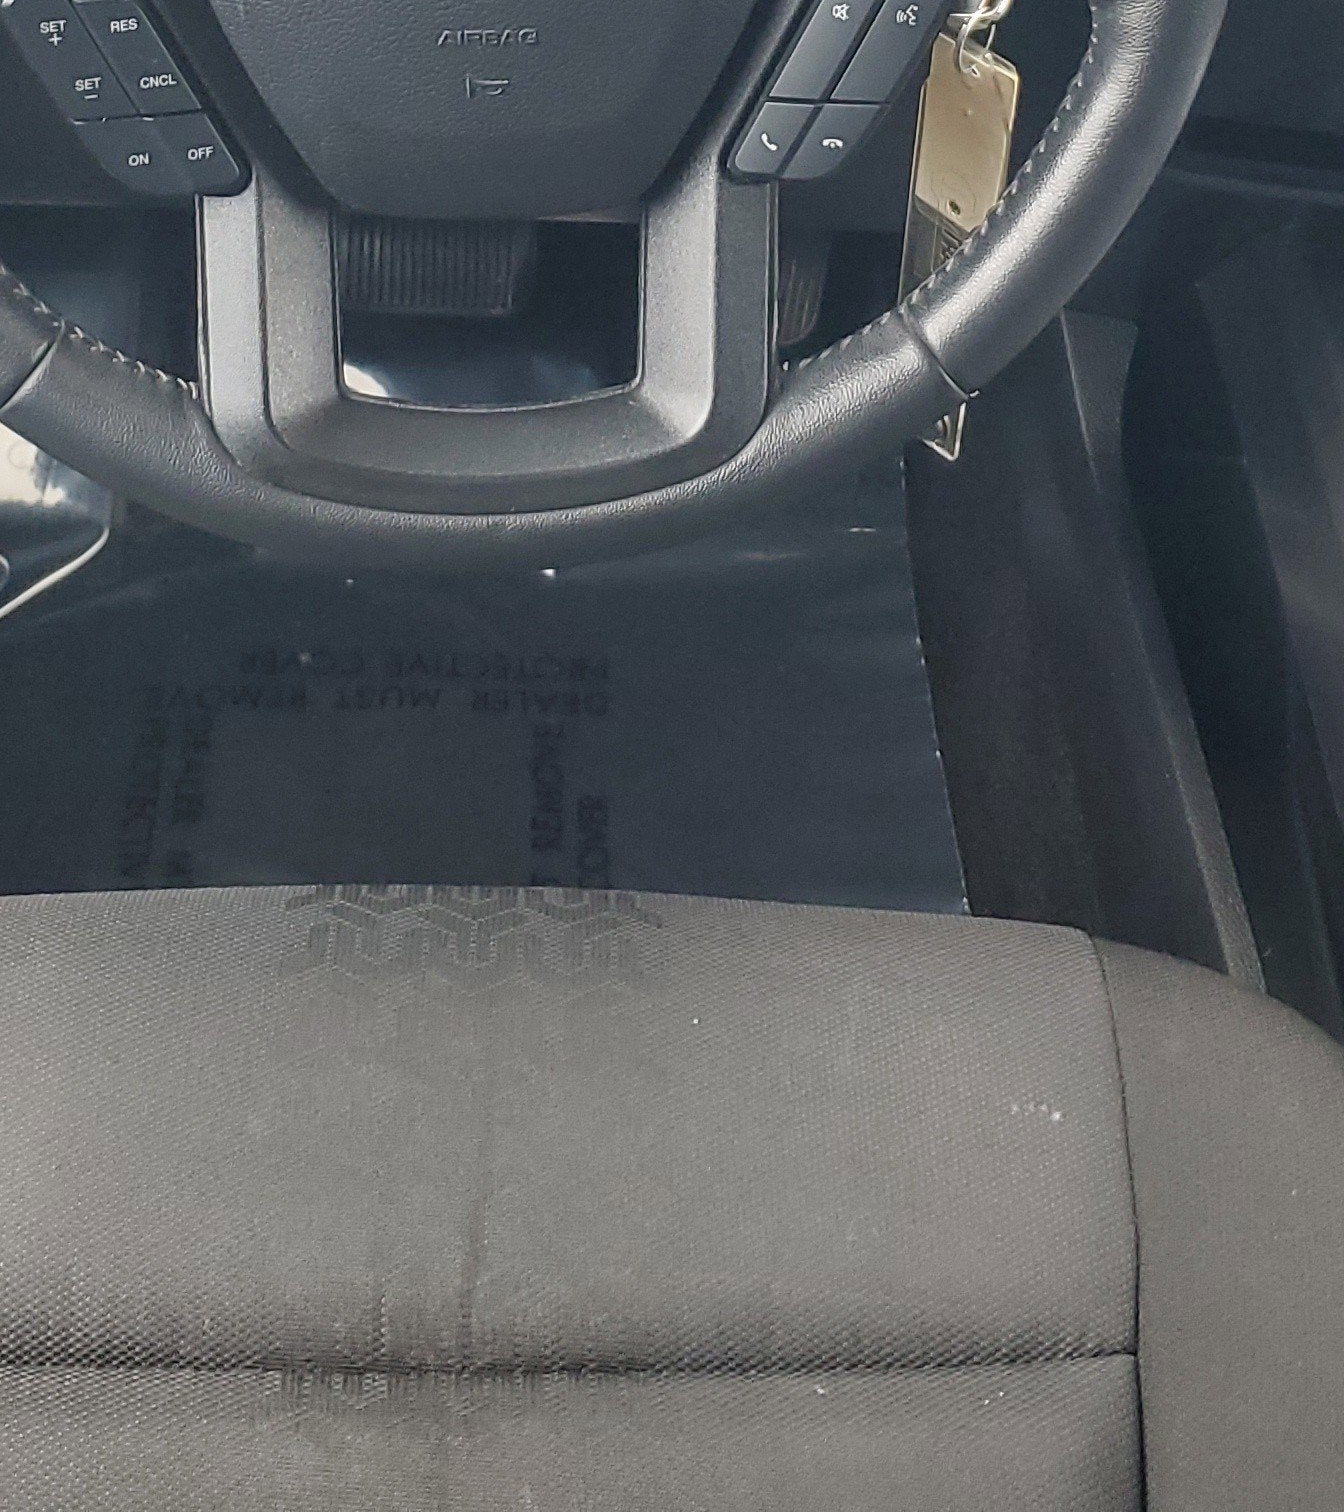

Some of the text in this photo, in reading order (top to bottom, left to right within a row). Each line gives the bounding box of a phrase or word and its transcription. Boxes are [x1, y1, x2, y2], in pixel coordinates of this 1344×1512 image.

[40, 19, 67, 34] SET
[110, 18, 138, 34] RES
[75, 76, 102, 91] SET
[140, 74, 177, 89] CNCL
[128, 152, 150, 167] ON
[188, 146, 214, 161] OFF
